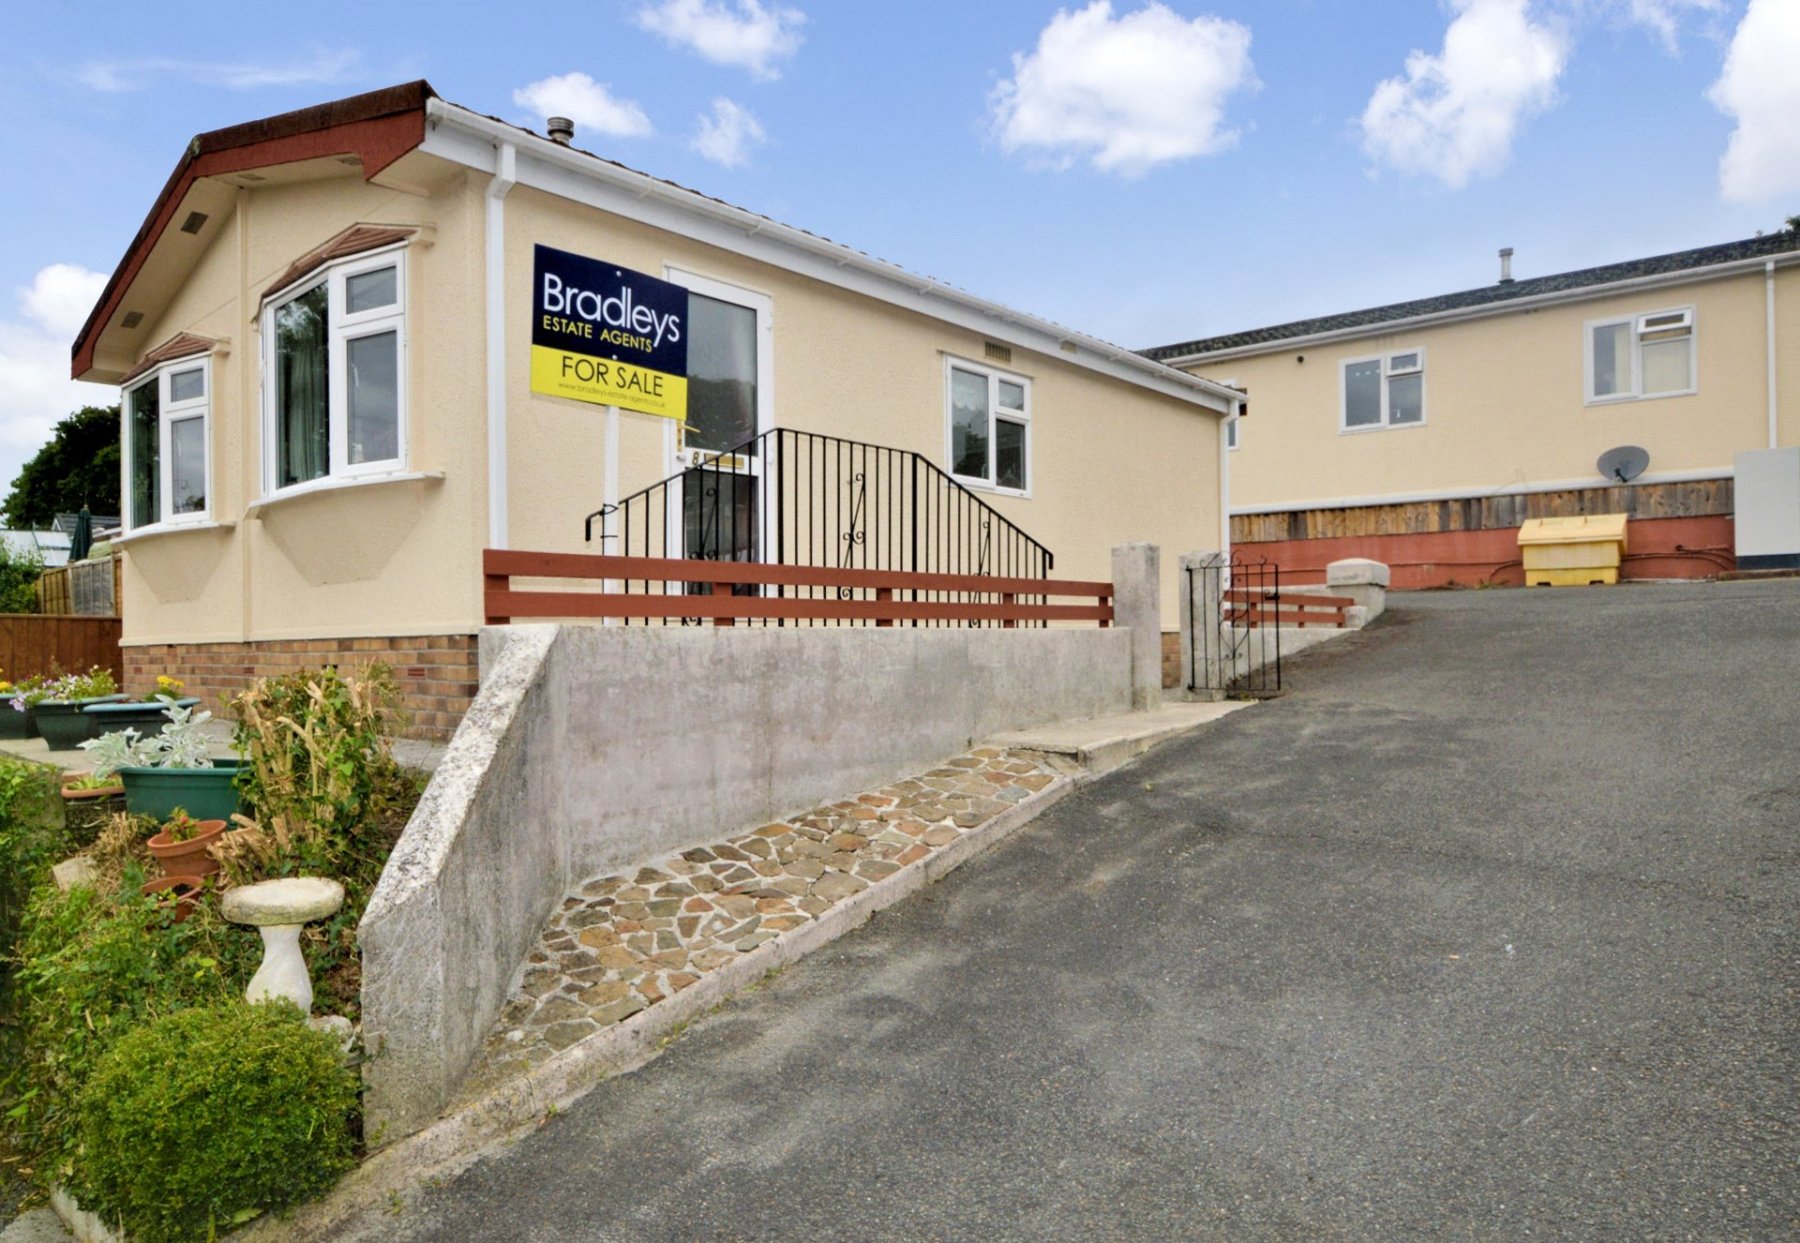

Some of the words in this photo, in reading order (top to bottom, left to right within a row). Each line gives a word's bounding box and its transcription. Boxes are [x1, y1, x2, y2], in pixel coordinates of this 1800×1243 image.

[543, 272, 680, 348] Bradleys
[543, 315, 593, 339] ESTATE
[600, 328, 653, 353] AGENTS
[561, 355, 609, 386] FOR
[615, 366, 664, 398] SALE
[692, 452, 700, 465] 8
